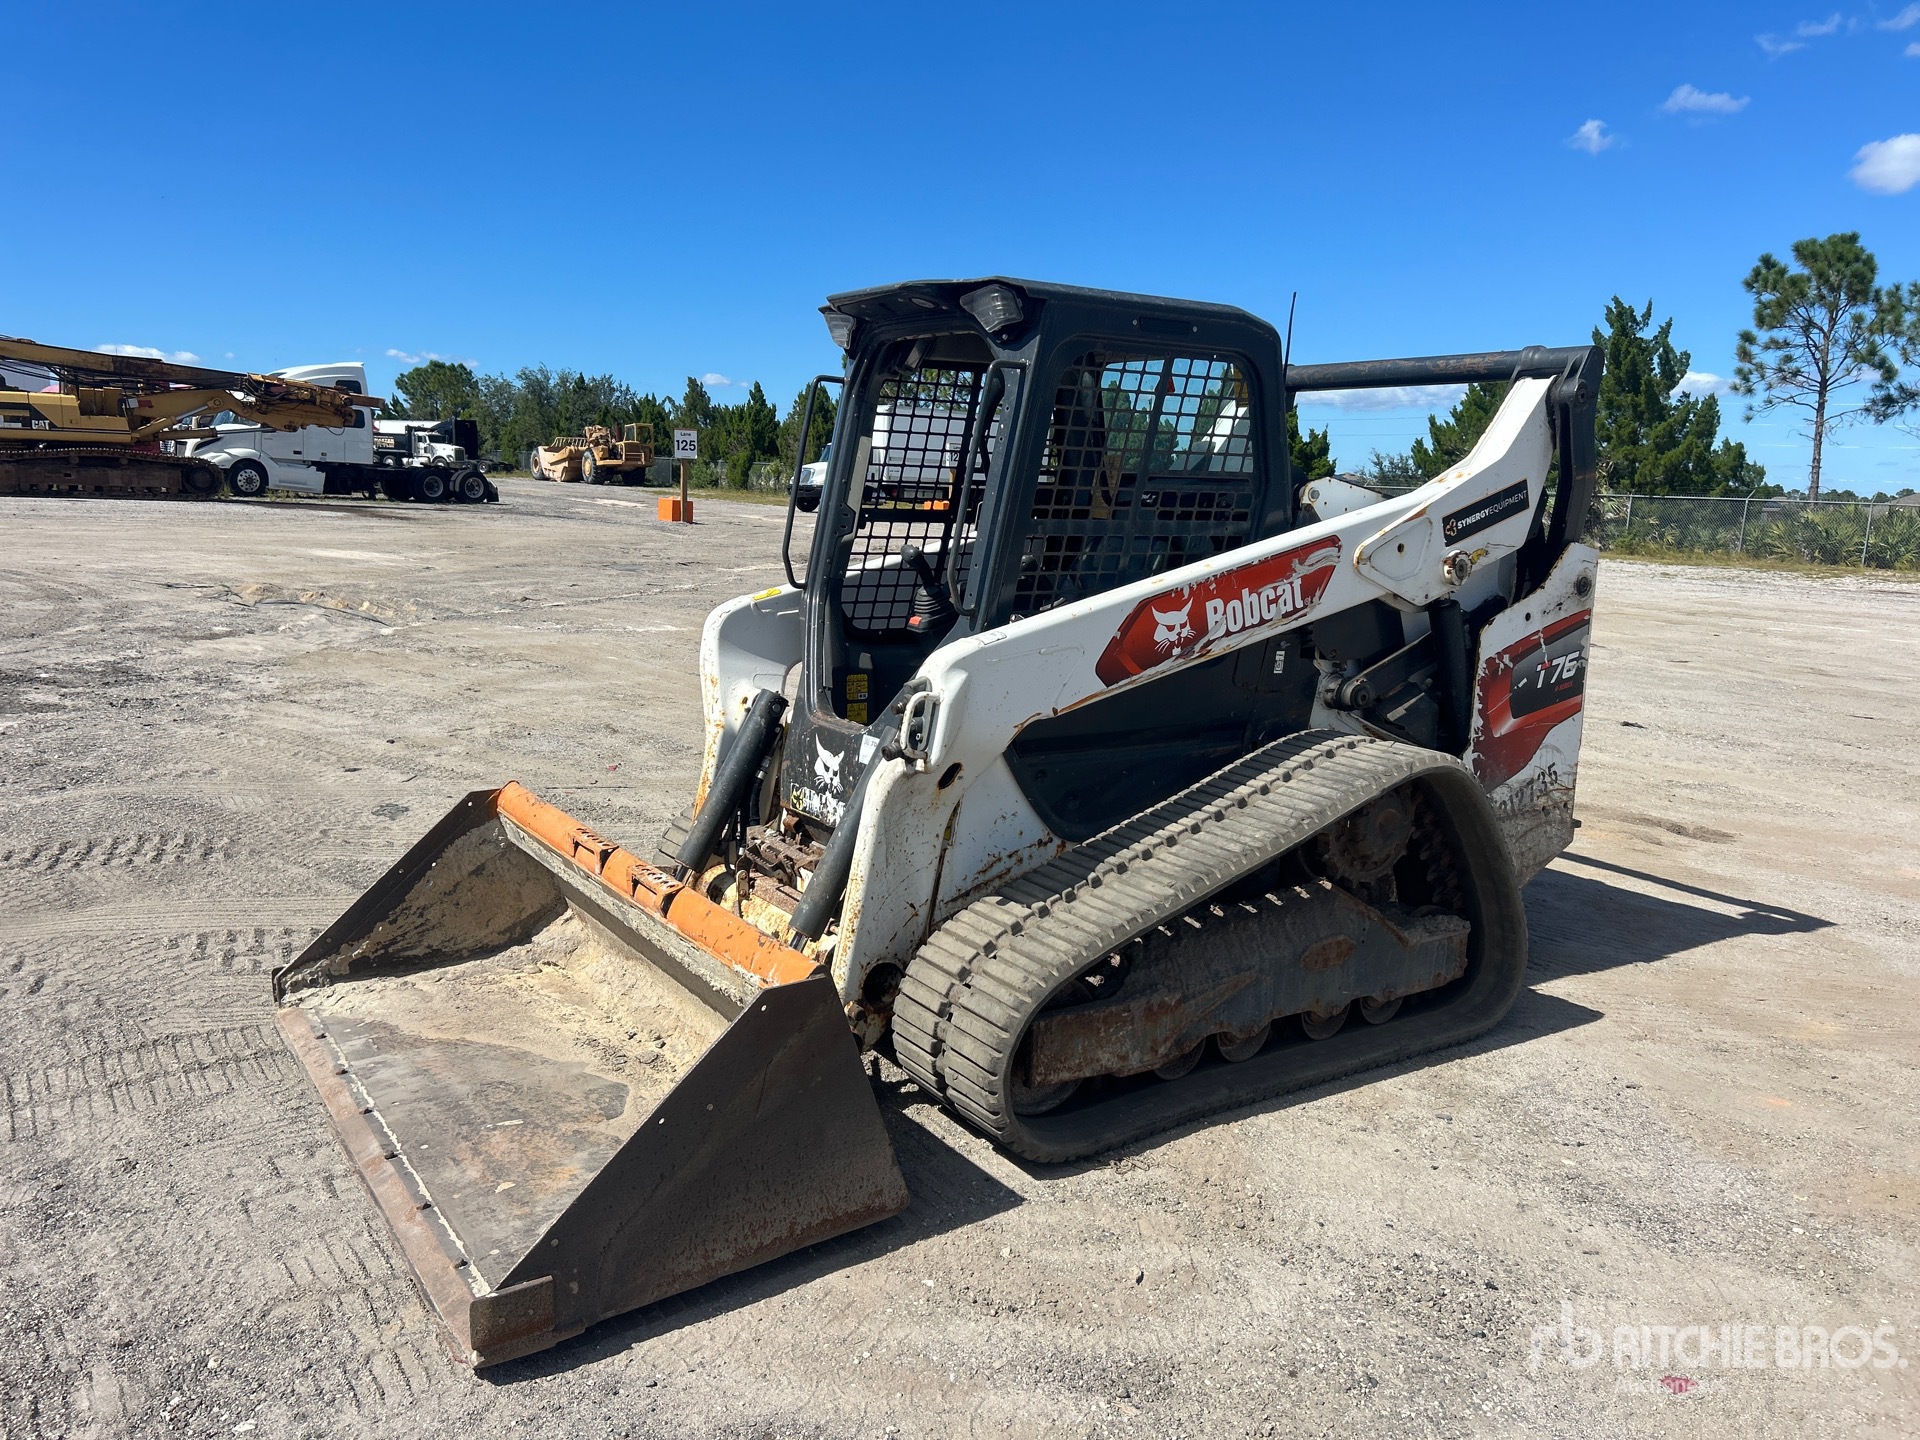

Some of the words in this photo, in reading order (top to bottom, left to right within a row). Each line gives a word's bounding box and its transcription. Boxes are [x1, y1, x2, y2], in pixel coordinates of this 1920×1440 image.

[31, 419, 50, 430] CAT
[676, 439, 696, 451] 125
[1205, 578, 1304, 641] Bobcat
